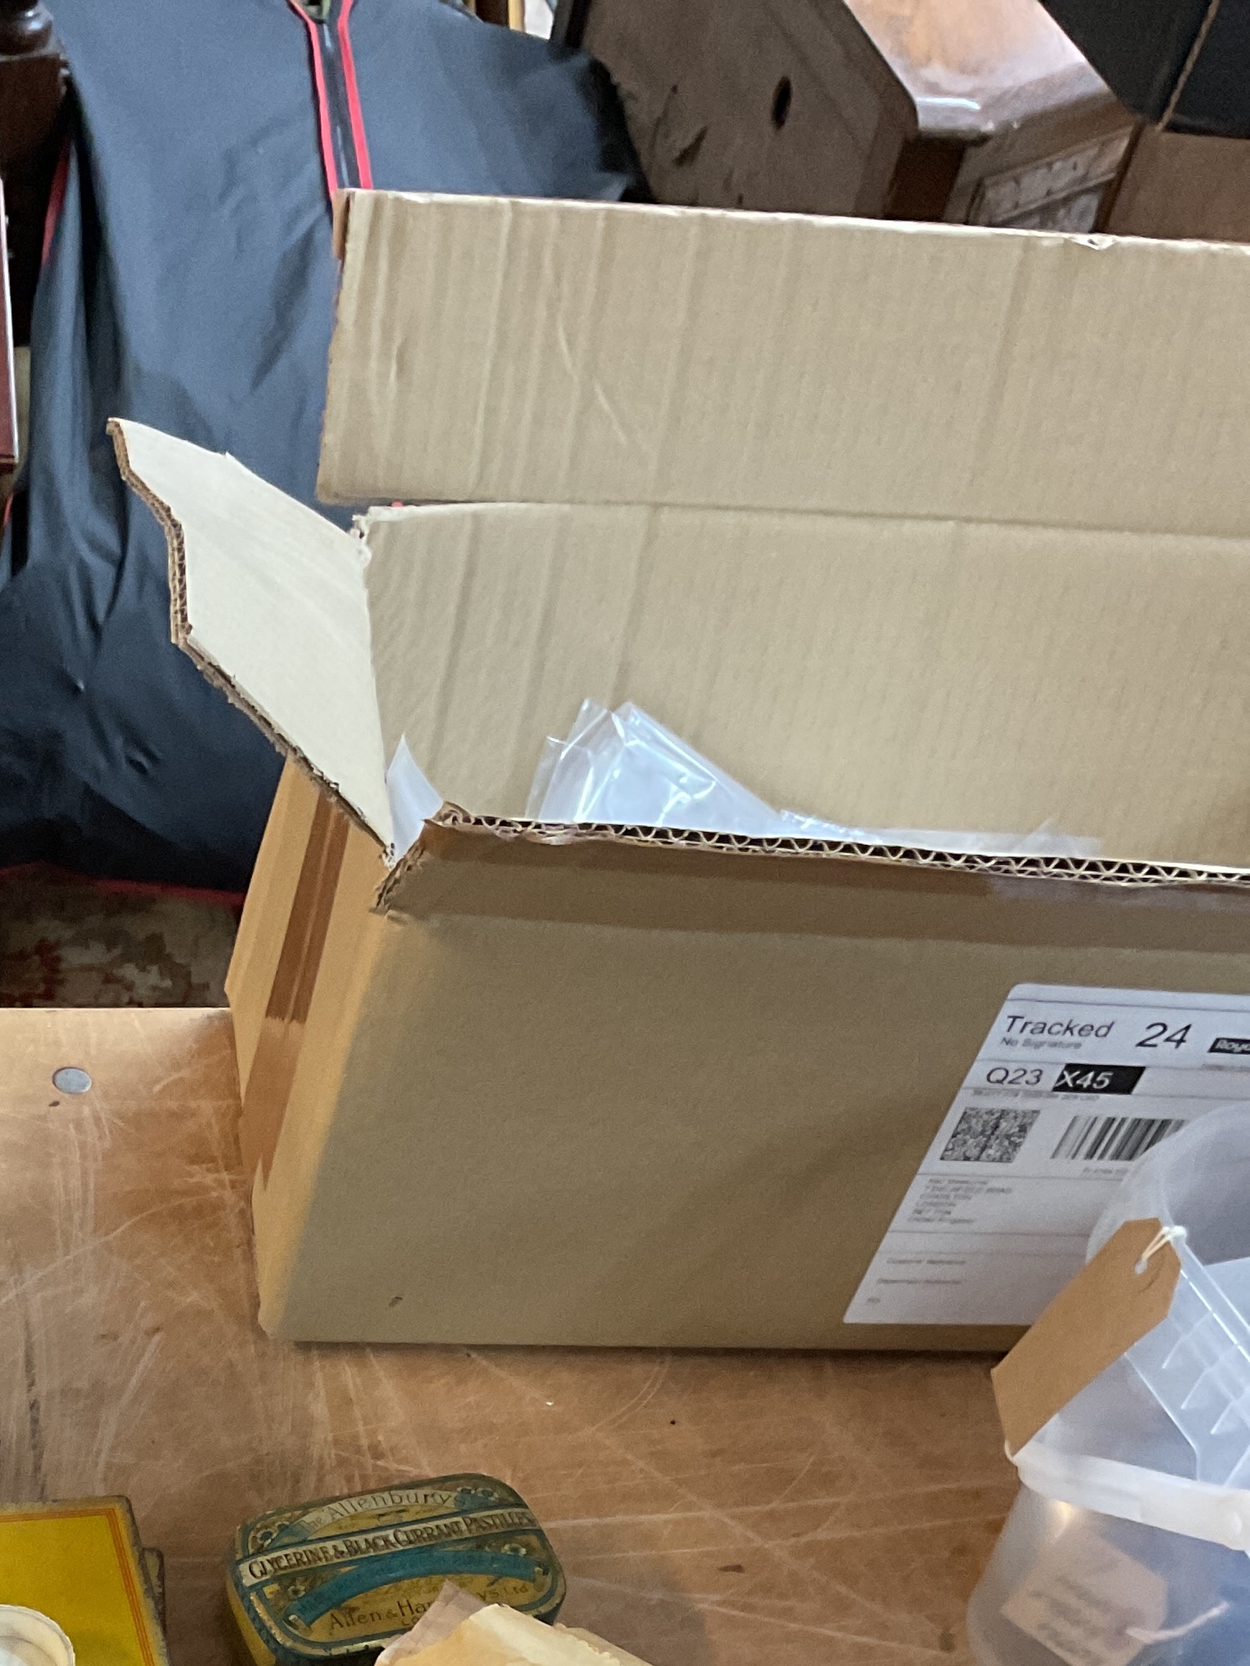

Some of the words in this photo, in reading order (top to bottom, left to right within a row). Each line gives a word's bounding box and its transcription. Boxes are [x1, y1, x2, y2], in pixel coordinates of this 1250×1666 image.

[1005, 1015, 1114, 1038] Tracked
[1135, 1022, 1193, 1049] 24
[986, 1066, 1044, 1086] Q23
[1055, 1069, 1113, 1089] X45
